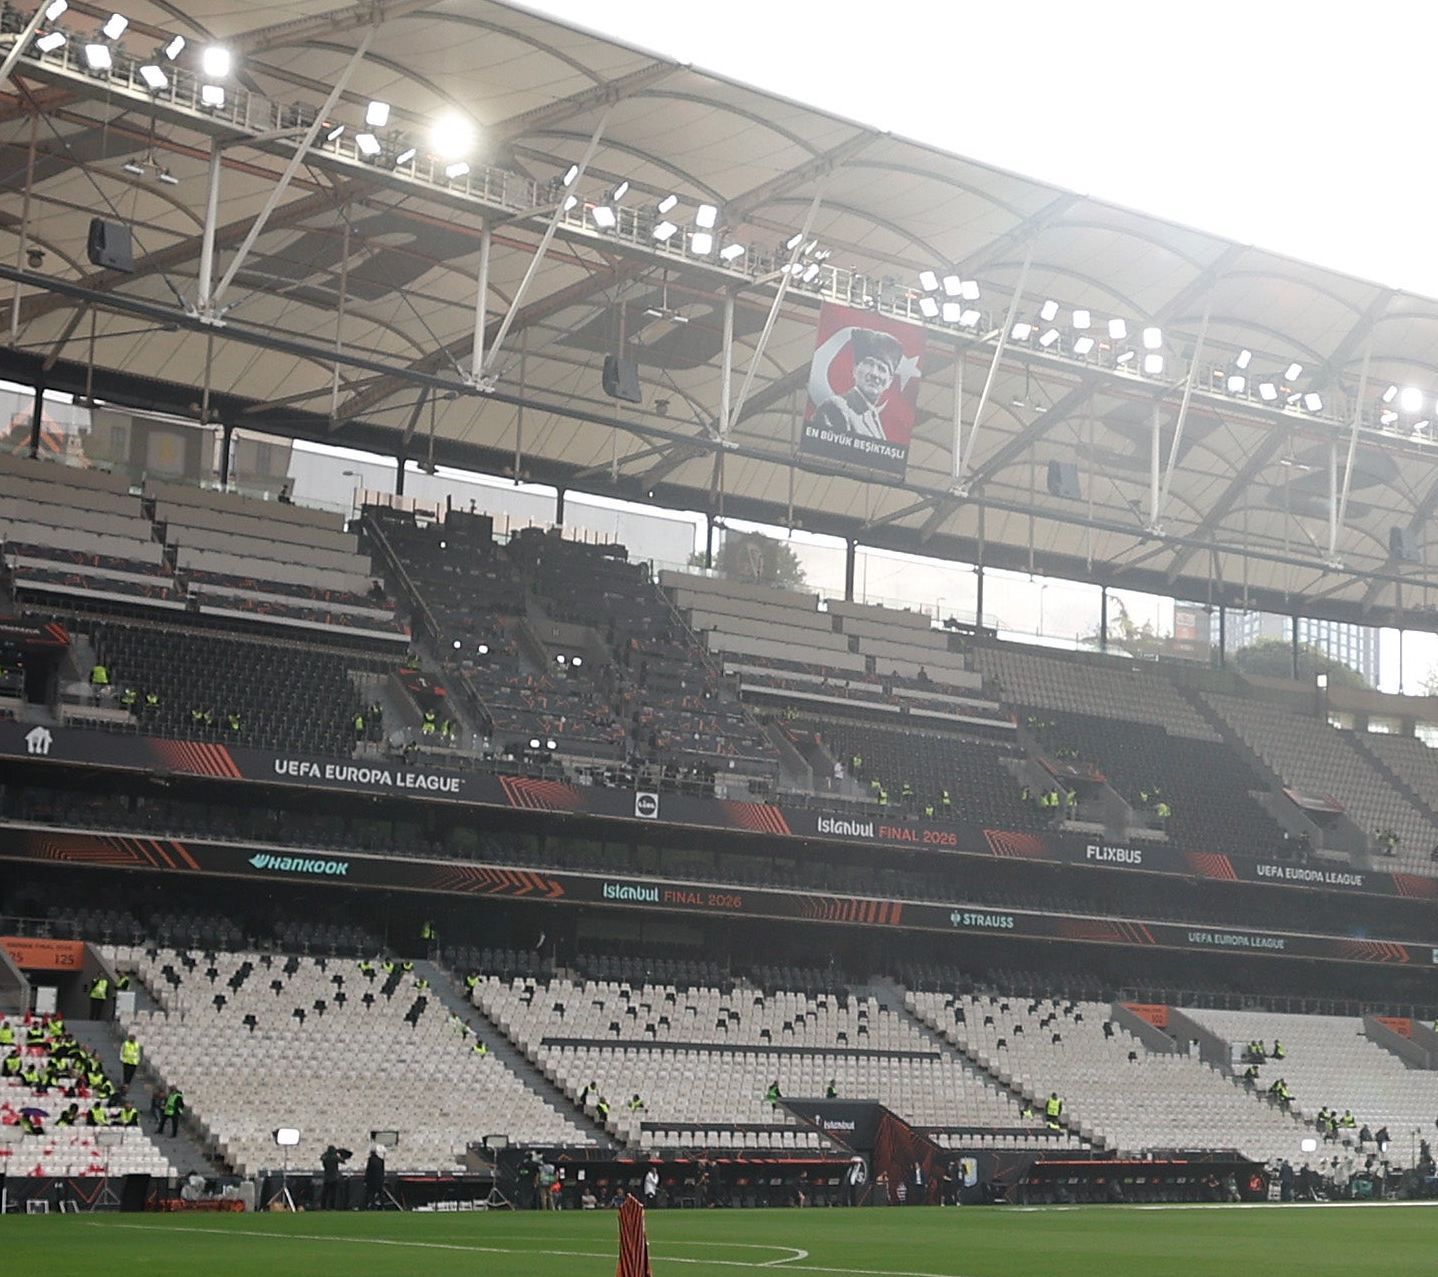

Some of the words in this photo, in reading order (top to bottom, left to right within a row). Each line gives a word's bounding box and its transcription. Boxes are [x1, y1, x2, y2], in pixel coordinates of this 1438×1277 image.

[805, 426, 819, 439] EN
[820, 429, 853, 447] BÜYÜK
[275, 758, 321, 779] UEFA
[325, 764, 393, 786] EUROPA
[396, 771, 460, 793] LEAGUE
[817, 816, 874, 838] Istanbul
[878, 825, 919, 842] FINAL
[923, 830, 958, 846] 2026
[1256, 864, 1284, 879] UEFA
[1285, 869, 1324, 883] EUROPA
[1325, 872, 1363, 887] LEAGUE
[603, 882, 660, 902] Istanbul
[664, 890, 704, 905] FINAL
[708, 894, 743, 908] 2026
[962, 912, 1014, 929] STRAUSS
[1188, 932, 1213, 944] UEFA
[1214, 935, 1250, 947] EUROPA
[1251, 938, 1285, 950] LEAGUE
